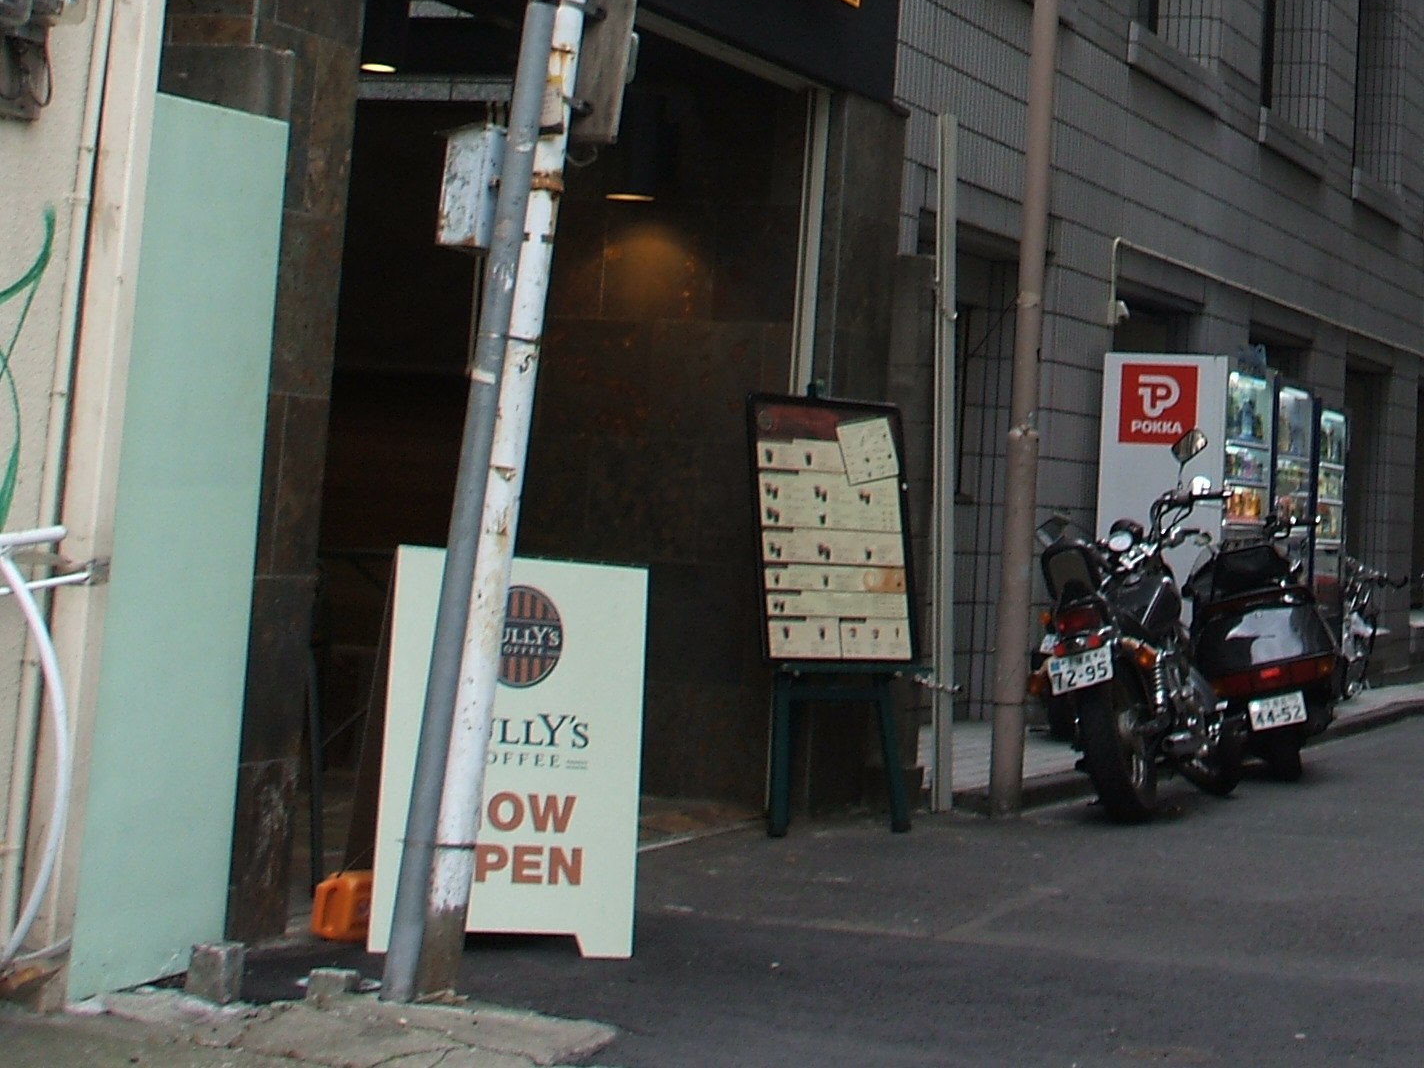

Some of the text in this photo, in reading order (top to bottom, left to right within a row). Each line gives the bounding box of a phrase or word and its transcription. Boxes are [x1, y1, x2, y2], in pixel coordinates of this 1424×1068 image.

[1131, 420, 1183, 434] POKKA
[487, 752, 560, 768] OFFEE
[480, 792, 576, 833] OW
[474, 844, 583, 885] PEN
